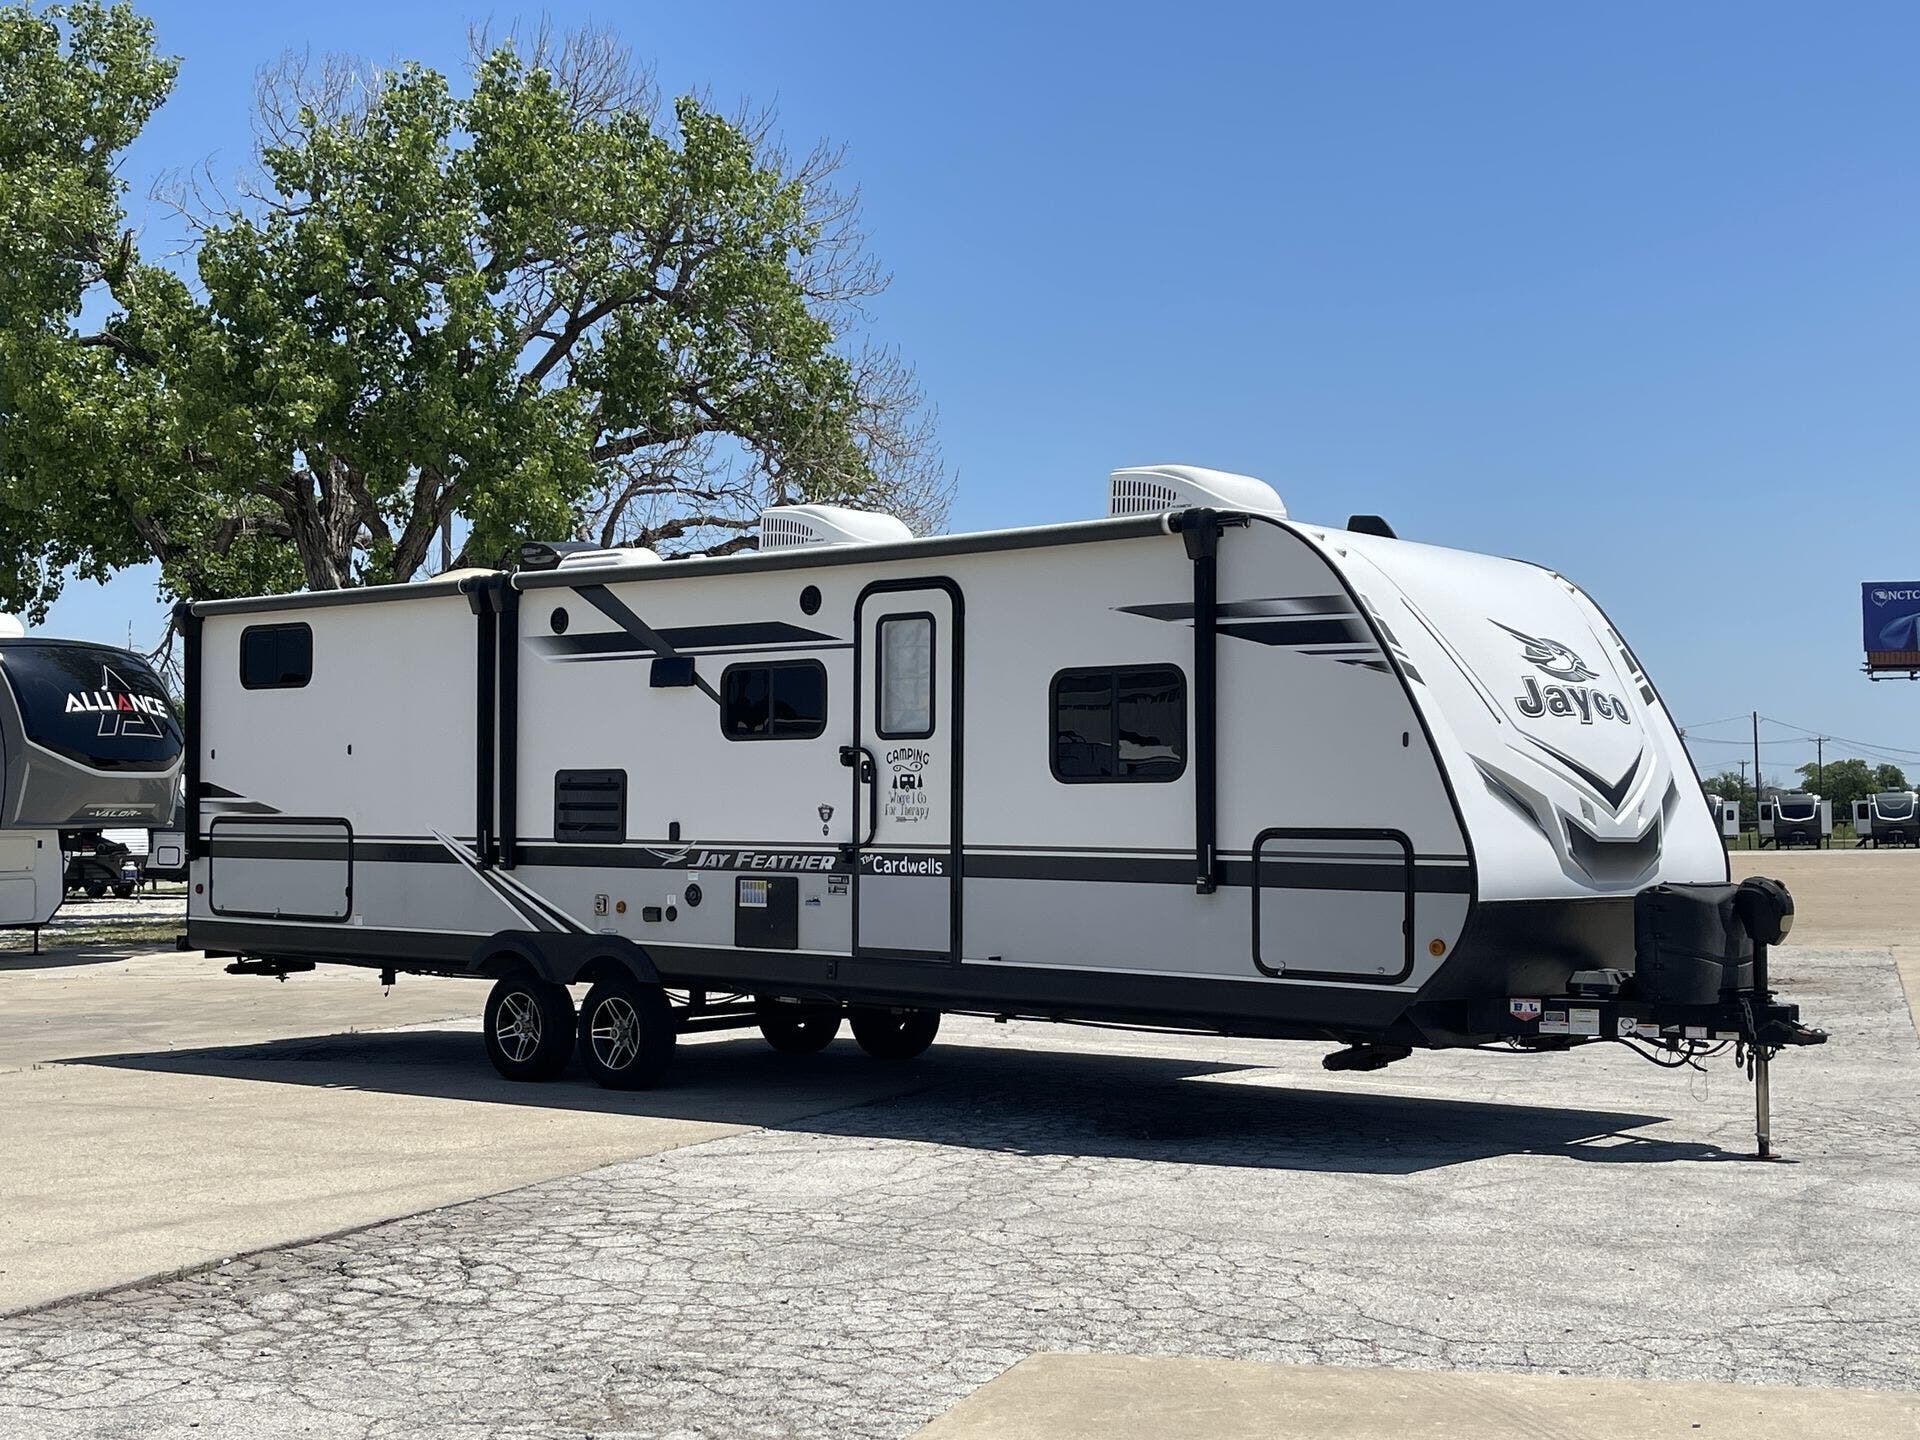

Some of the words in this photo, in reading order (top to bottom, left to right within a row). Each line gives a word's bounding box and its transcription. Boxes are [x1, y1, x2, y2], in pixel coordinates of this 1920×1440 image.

[1888, 590, 1920, 601] NCTC
[65, 691, 169, 719] ALLIANCE
[1514, 676, 1631, 725] Jayco
[886, 748, 931, 766] CAMPING
[94, 809, 138, 817] VALOR
[900, 804, 930, 820] Therapy
[687, 850, 731, 868] JAY
[733, 851, 836, 870] FEATHER
[860, 854, 875, 865] The
[873, 855, 943, 875] Cardwells
